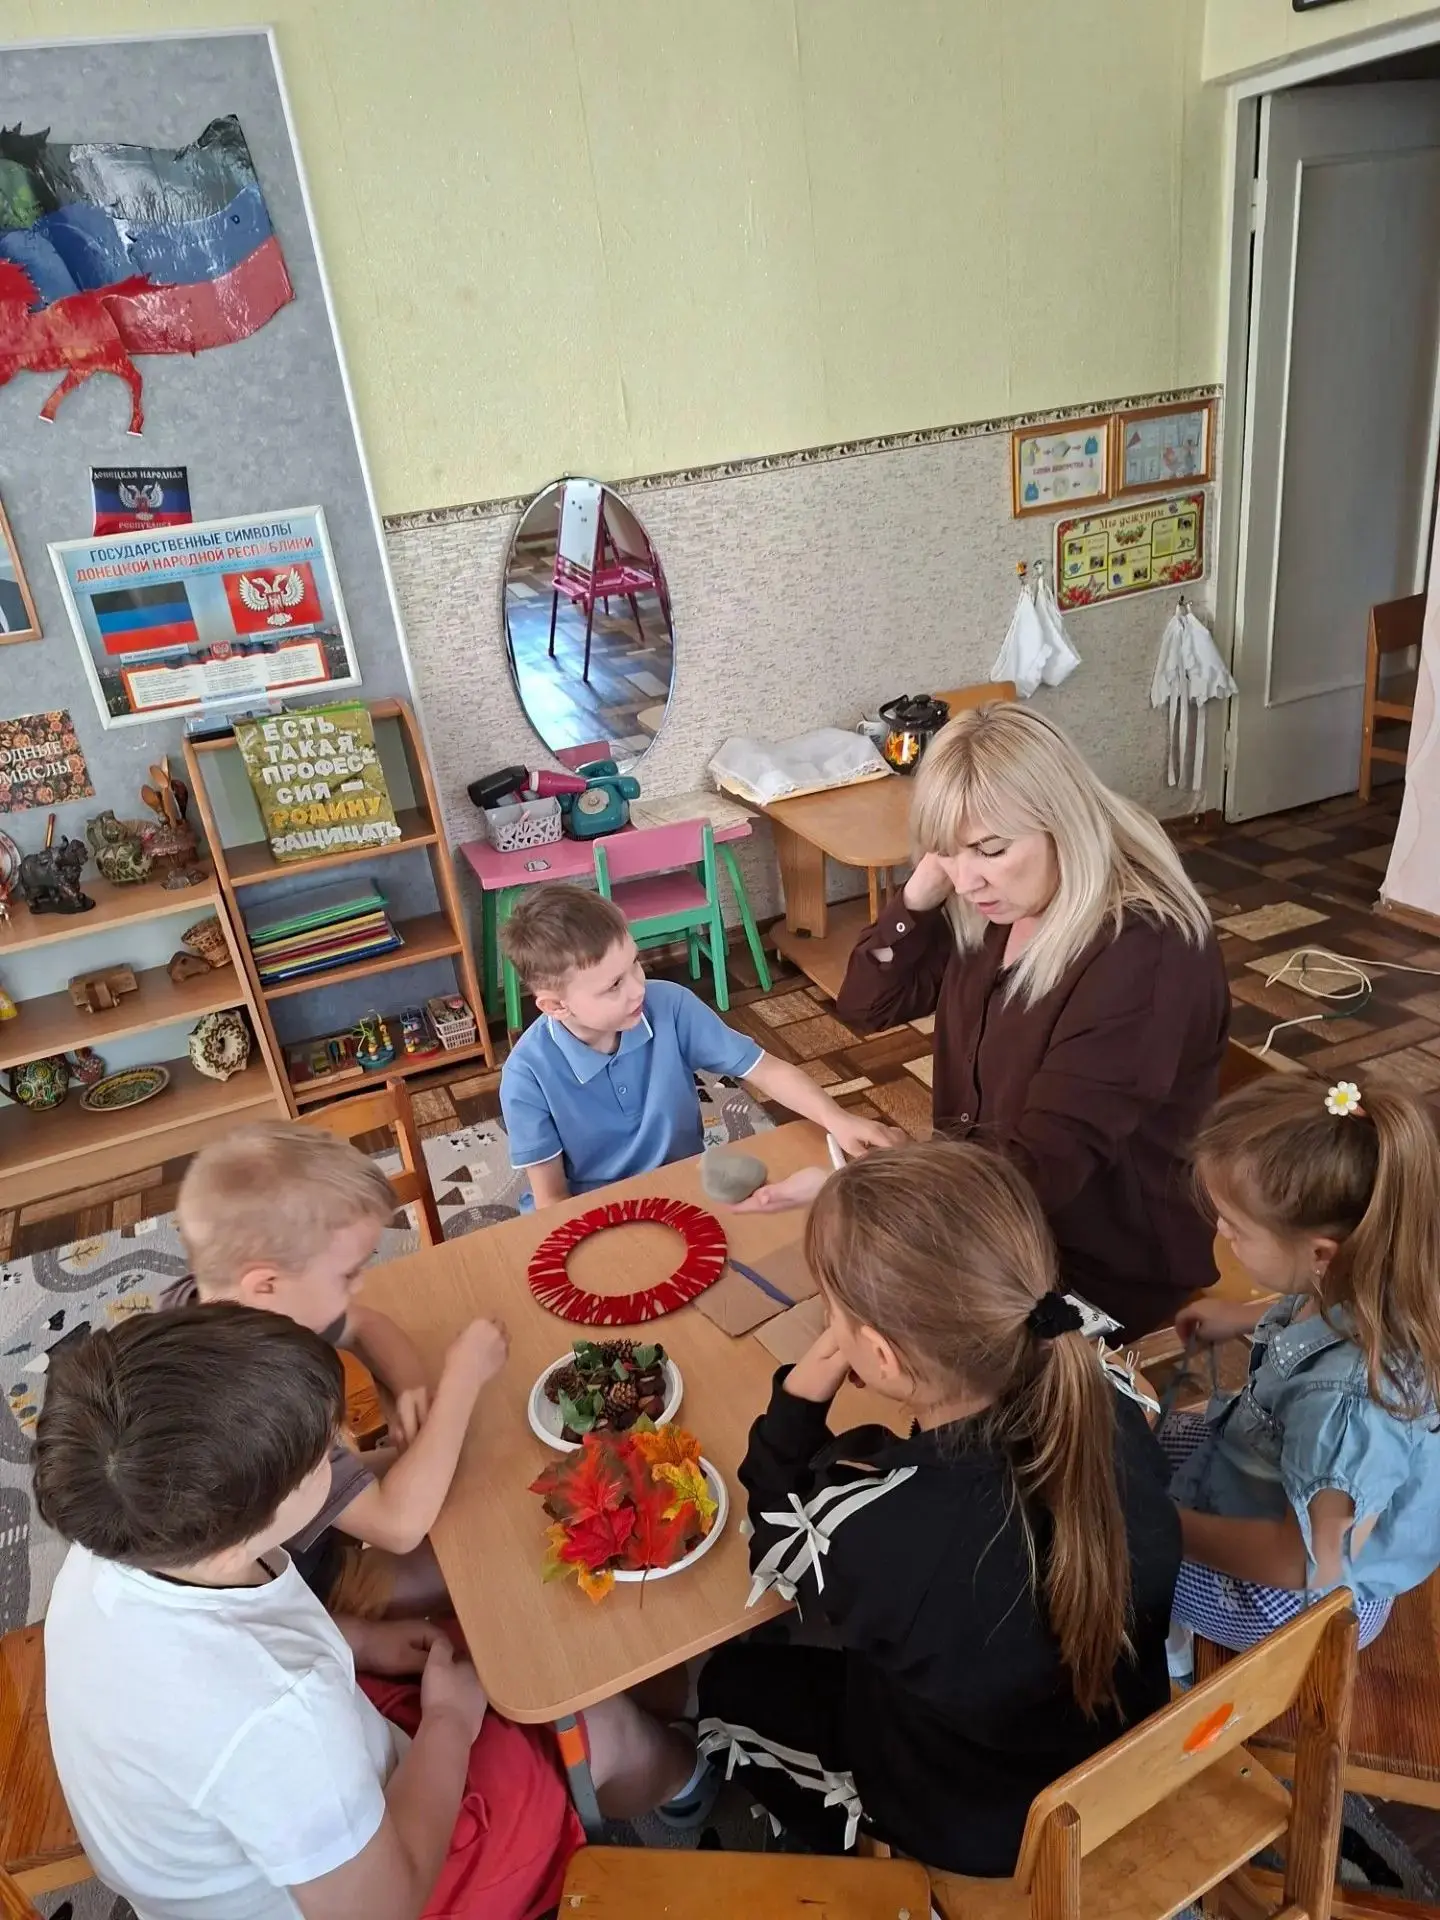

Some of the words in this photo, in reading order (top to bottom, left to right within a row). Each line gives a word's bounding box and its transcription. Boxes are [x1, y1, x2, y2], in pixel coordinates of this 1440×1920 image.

[94, 471, 137, 480] ДОНЕЦКАЯ
[140, 471, 183, 480] НАРОДНАЯ
[90, 531, 221, 563] ГОСУДАРСТВЕННЫЕ
[225, 522, 292, 543] СИМВОЛЫ
[76, 557, 151, 583] ДОНЕЦКОЙ
[153, 547, 225, 570] НАРОДНОЙ
[227, 536, 314, 560] РЕСПУБЛИКИ
[262, 716, 335, 742] ЕСТЬ
[264, 735, 354, 764] ТАКАЯ
[276, 782, 332, 804] СИЯ
[271, 821, 402, 854] ЗАЩИЩАТЬ
